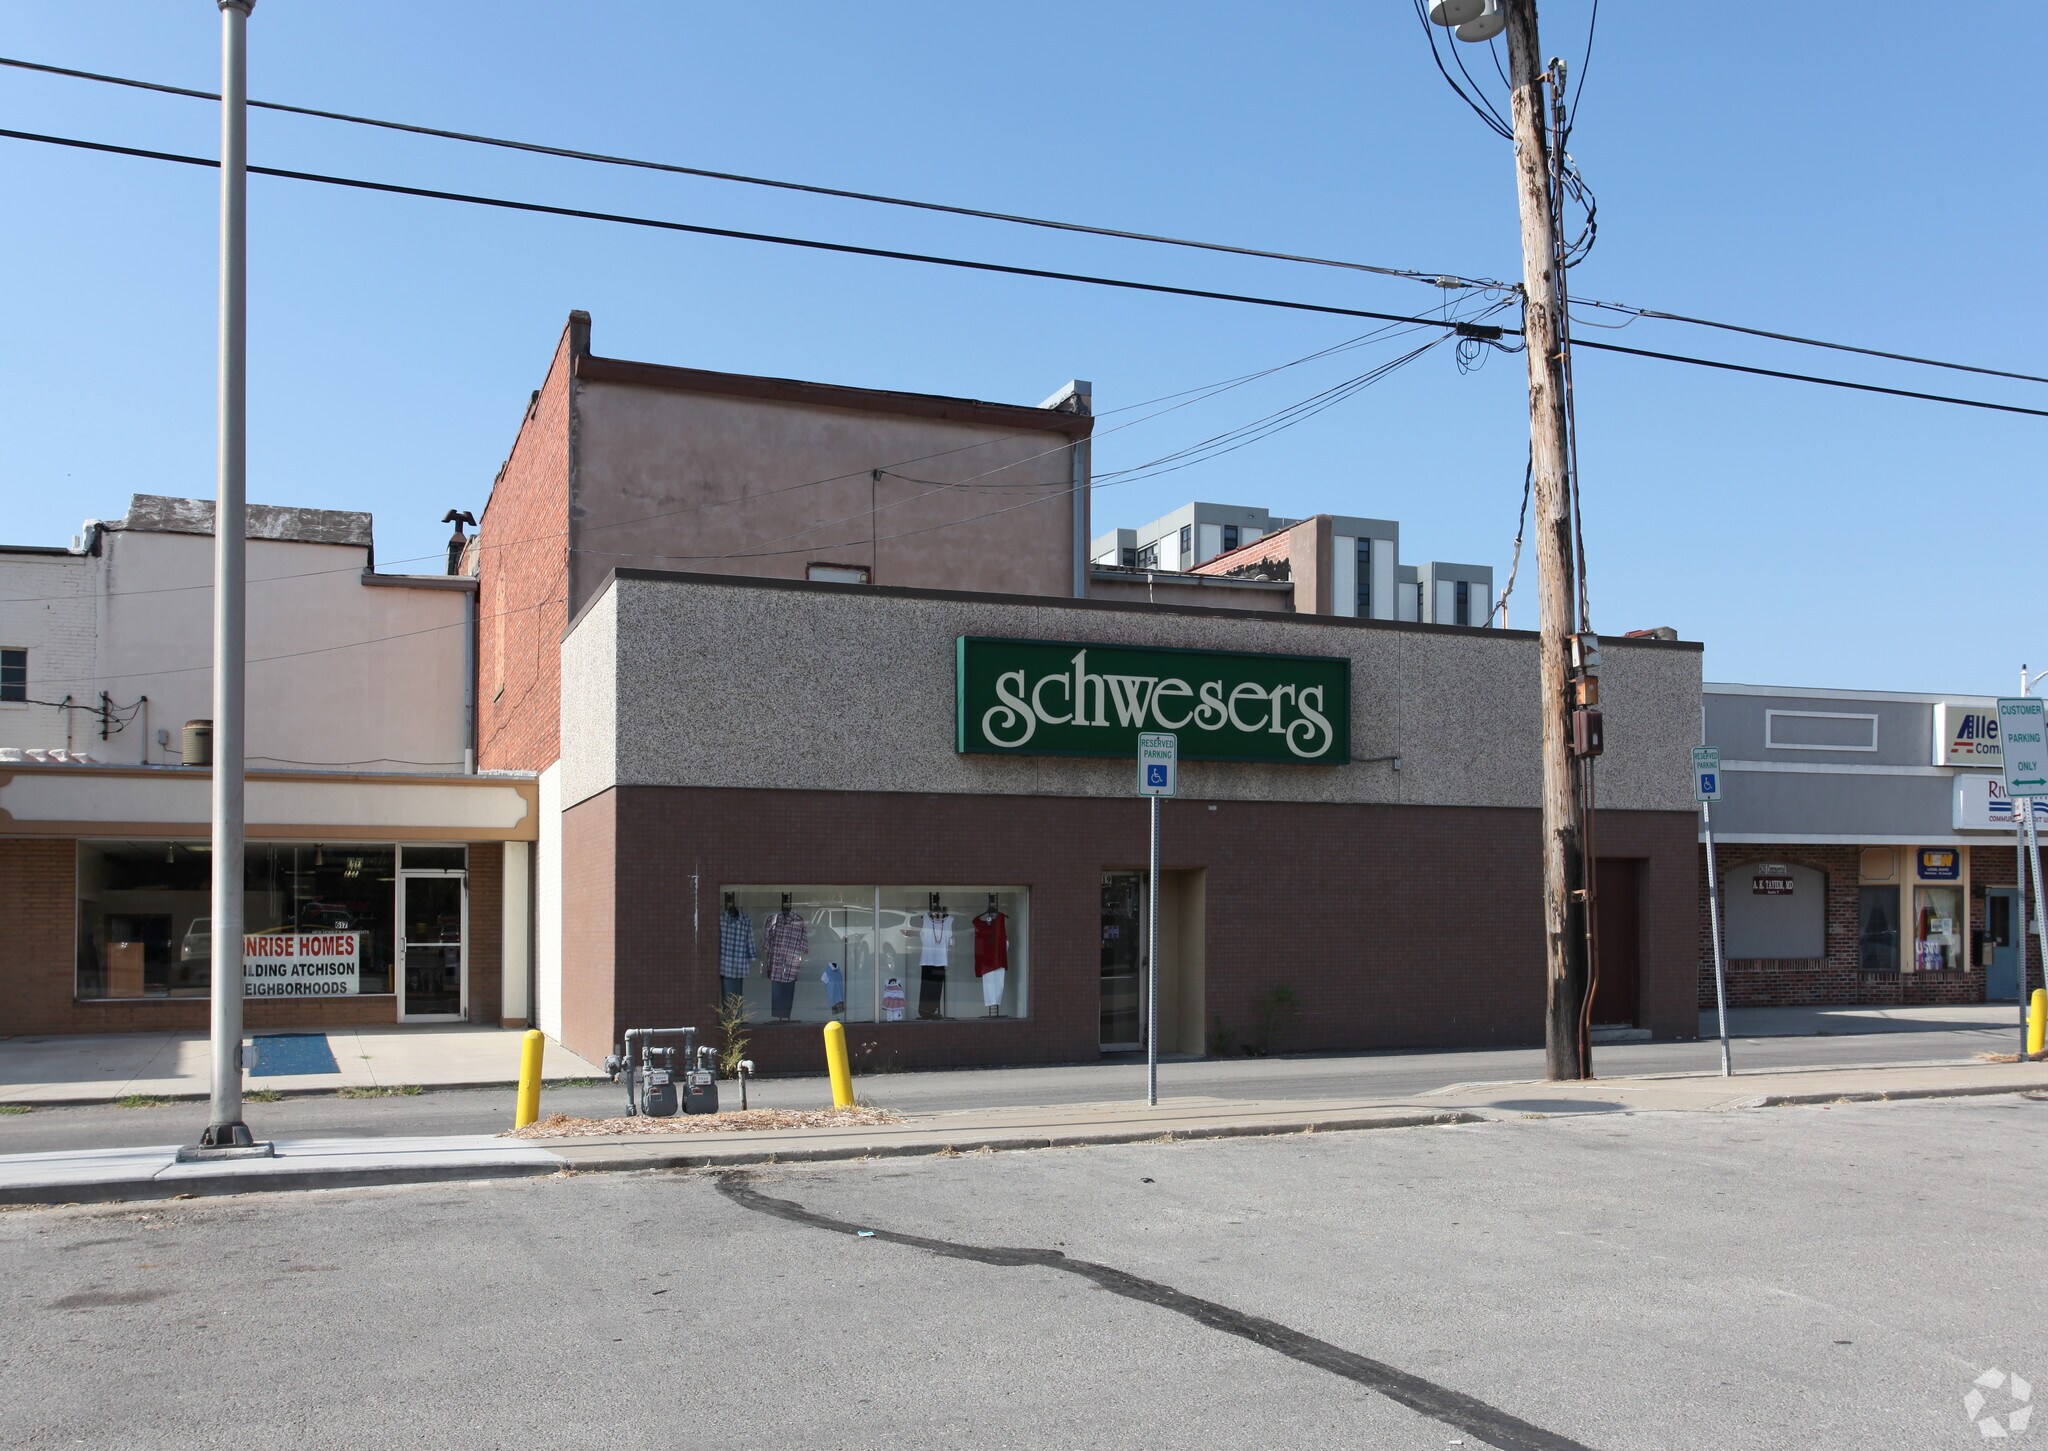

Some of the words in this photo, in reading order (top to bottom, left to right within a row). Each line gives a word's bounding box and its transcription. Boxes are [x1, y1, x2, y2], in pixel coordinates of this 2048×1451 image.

[2001, 705, 2041, 715] CUSTOMER
[1957, 715, 1998, 739] Alle
[2008, 733, 2041, 743] PARKING
[1142, 739, 1174, 749] RESERVED
[1975, 742, 2002, 755] Com
[1144, 750, 1172, 759] PARKING
[2018, 761, 2037, 771] ONLY
[1923, 853, 1953, 867] USW
[335, 921, 348, 930] 617
[299, 935, 355, 957] HOMES
[243, 964, 287, 977] ILDING
[291, 962, 355, 976] ATCHISON
